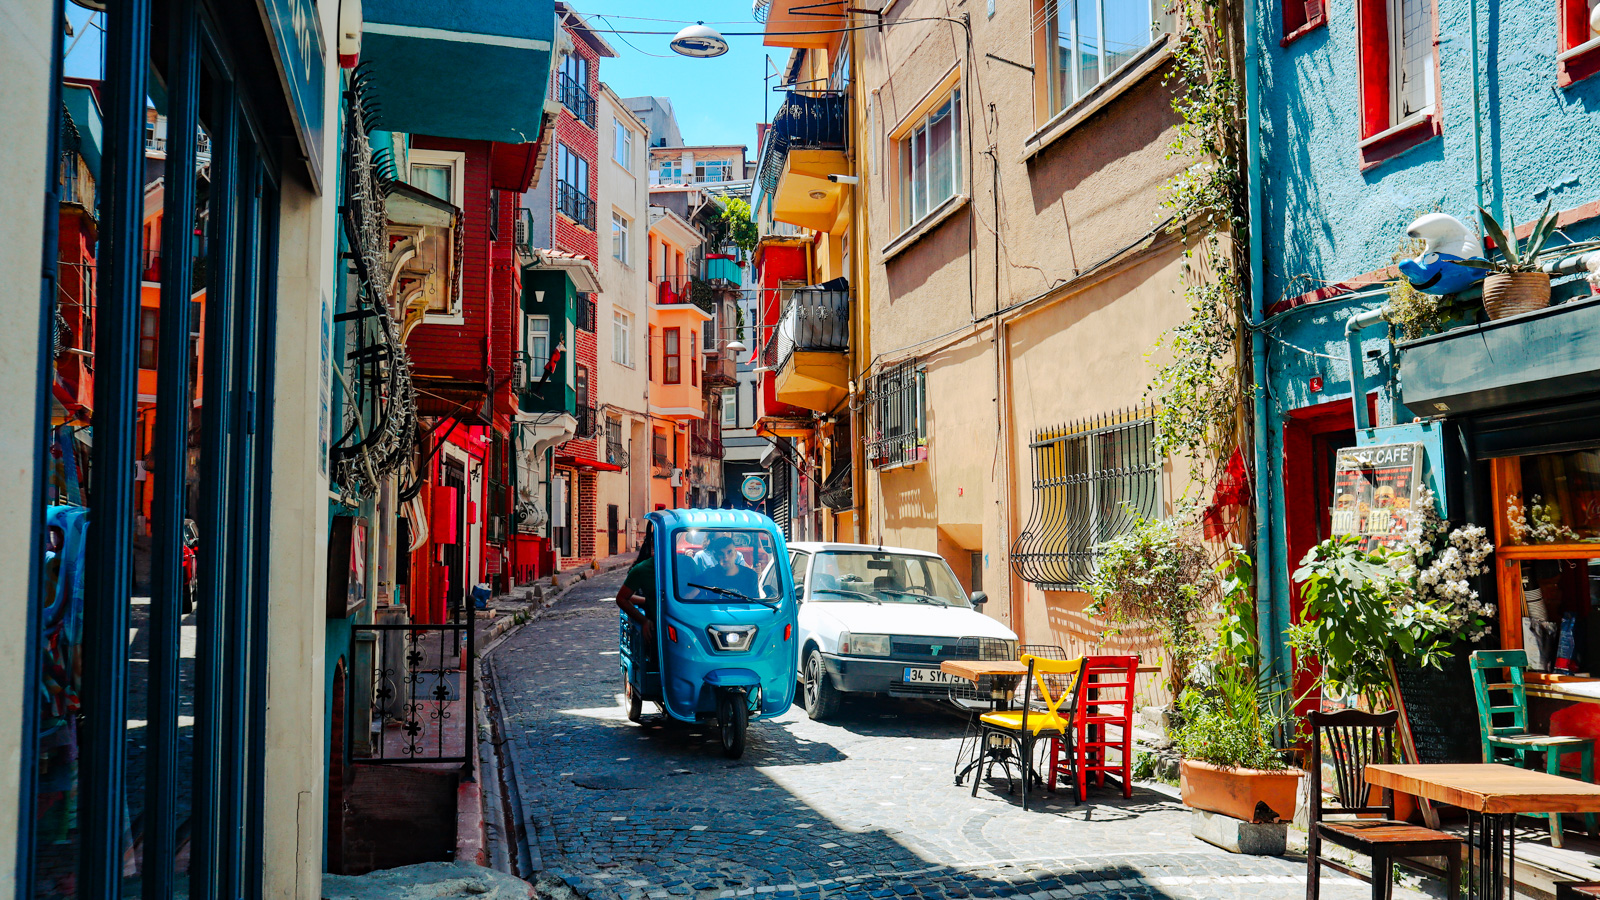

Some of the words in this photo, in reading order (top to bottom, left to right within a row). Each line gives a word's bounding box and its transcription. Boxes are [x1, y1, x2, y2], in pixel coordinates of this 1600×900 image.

[1313, 378, 1318, 388] 2
[1334, 512, 1351, 532] 110
[1370, 512, 1388, 533] 110
[911, 669, 924, 681] 34
[930, 670, 947, 682] SYK
